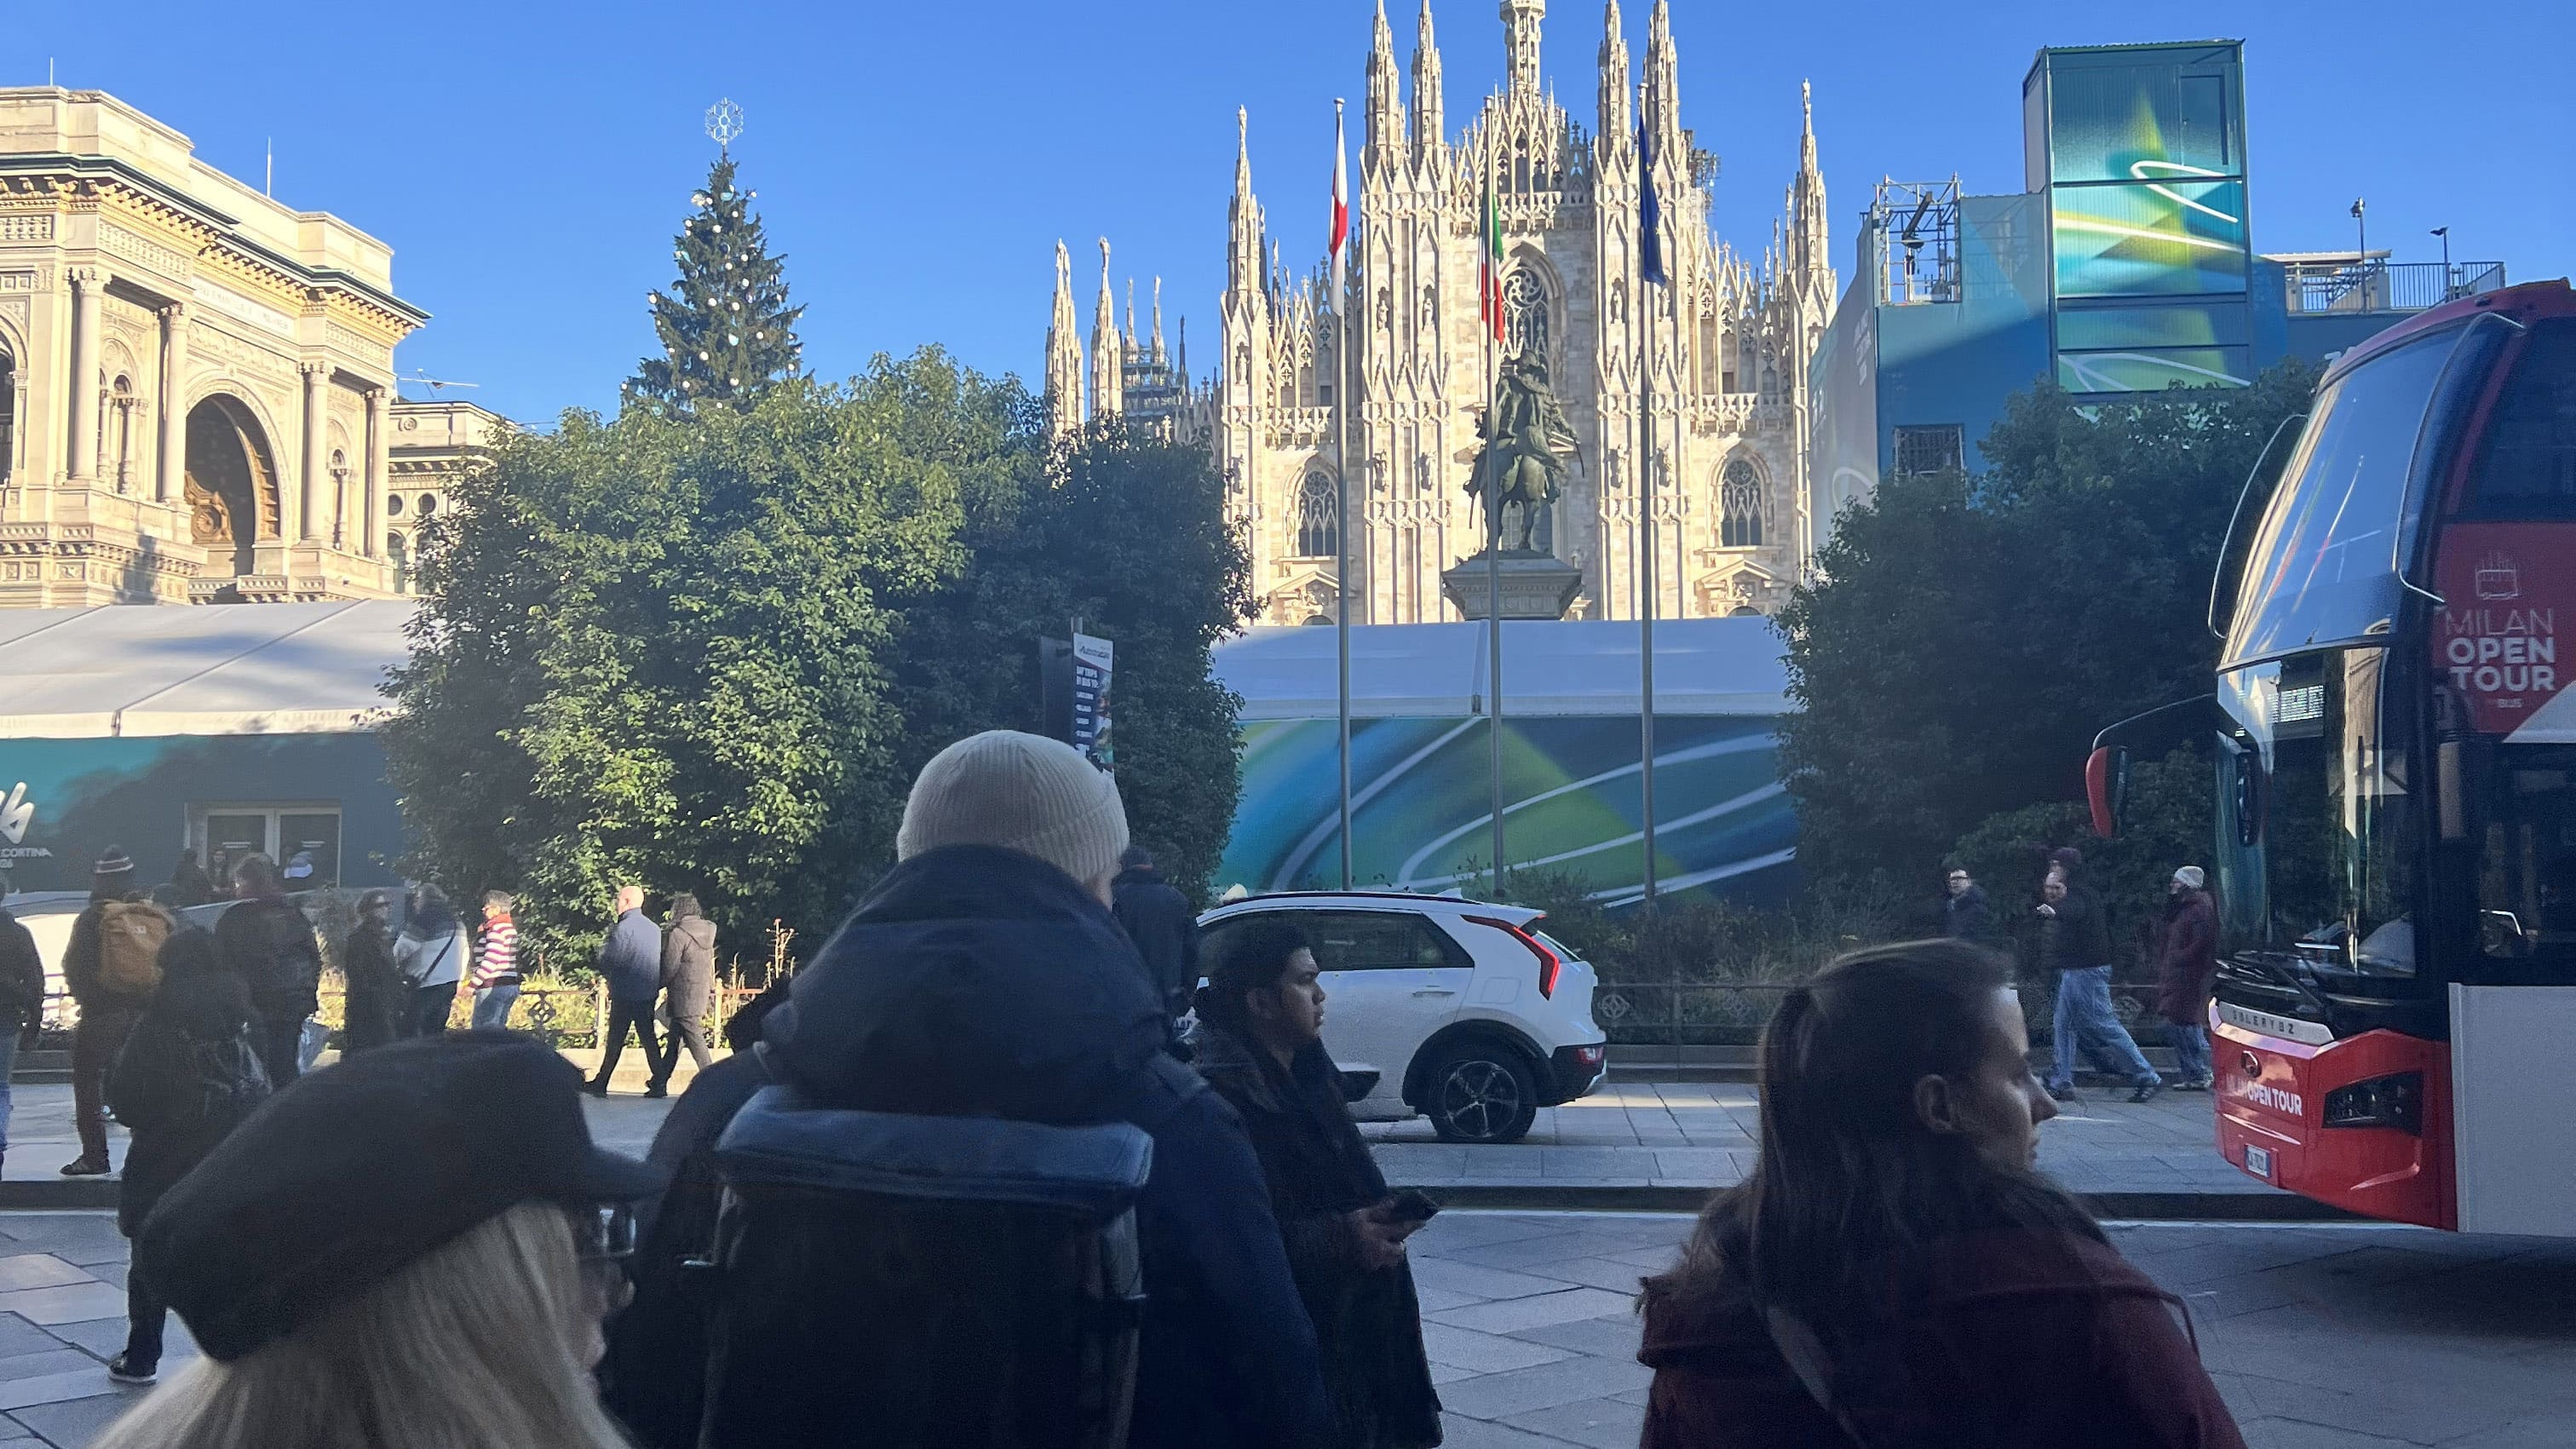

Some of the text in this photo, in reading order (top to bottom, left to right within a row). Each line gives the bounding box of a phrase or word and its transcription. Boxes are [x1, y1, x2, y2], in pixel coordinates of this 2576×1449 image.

[2445, 607, 2555, 635] MILAN
[2447, 636, 2555, 664] OPEN
[2448, 665, 2555, 692] TOUR
[2, 847, 53, 858] CORTINA
[2247, 1080, 2272, 1107] OPEN
[2272, 1088, 2303, 1117] TOUR
